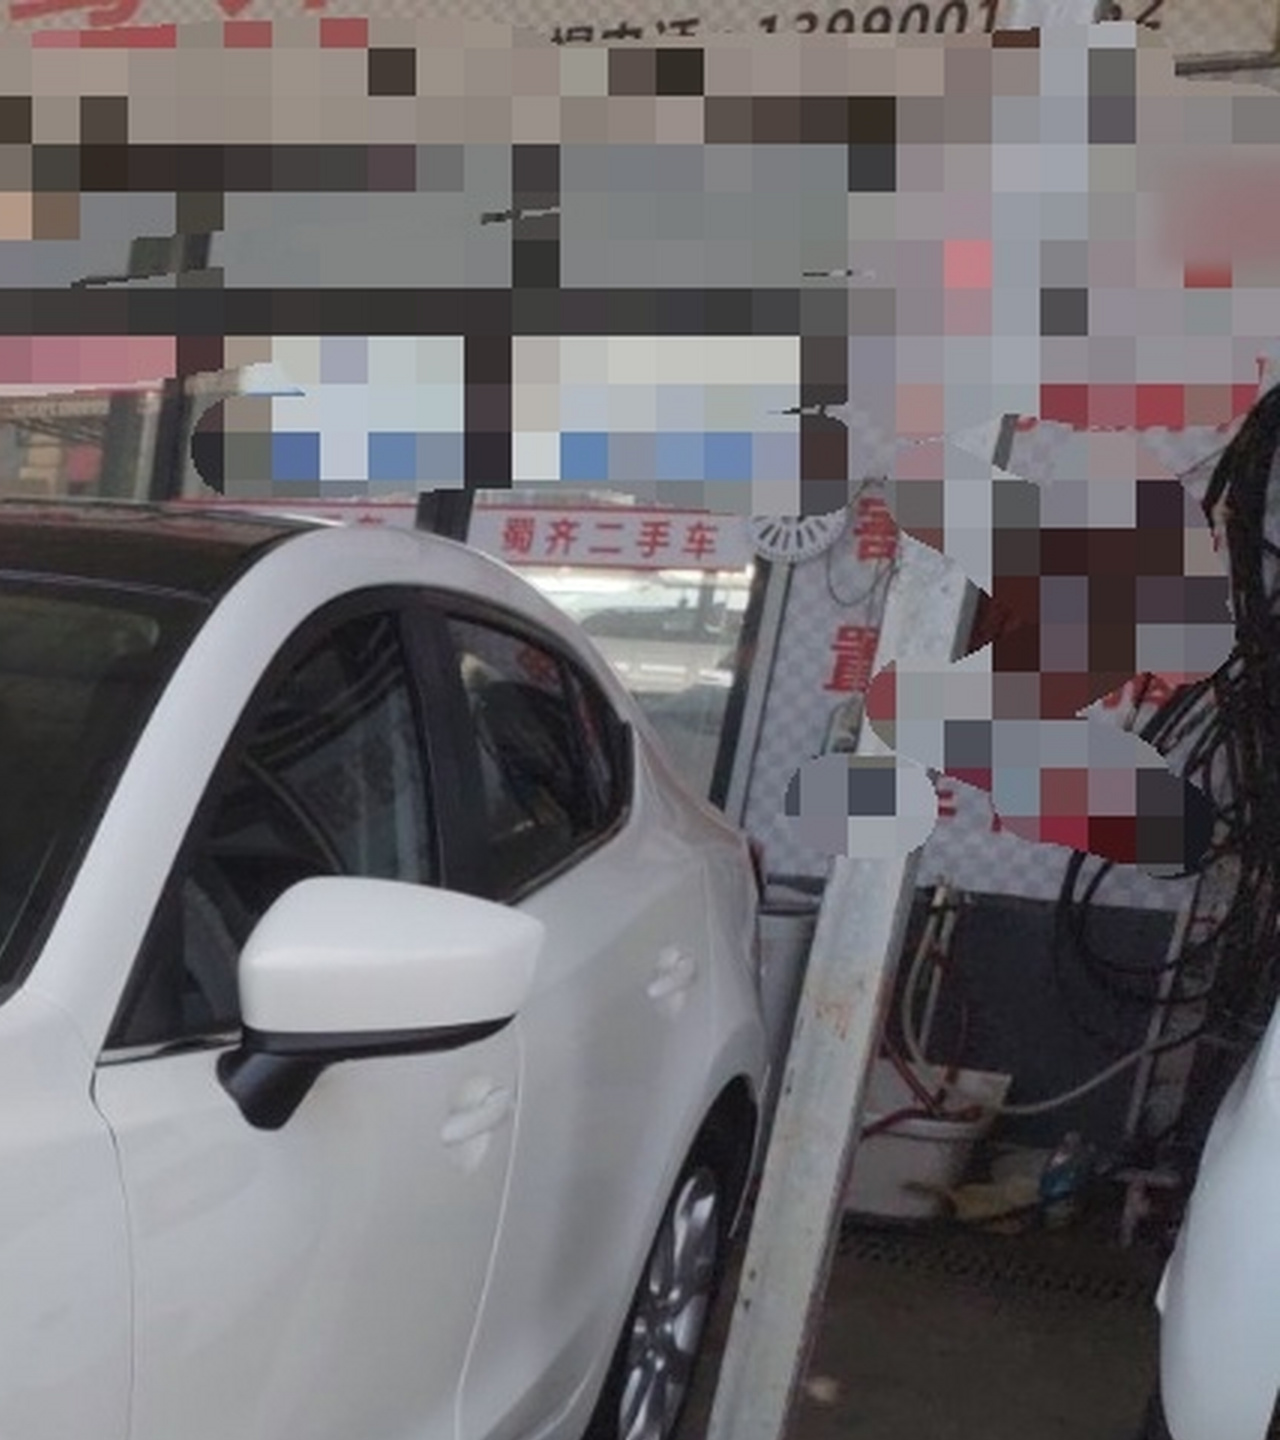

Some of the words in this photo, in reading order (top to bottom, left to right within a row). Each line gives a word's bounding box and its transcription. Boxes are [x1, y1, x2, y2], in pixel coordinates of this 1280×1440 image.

[502, 517, 720, 562] 蜀齐二手车
